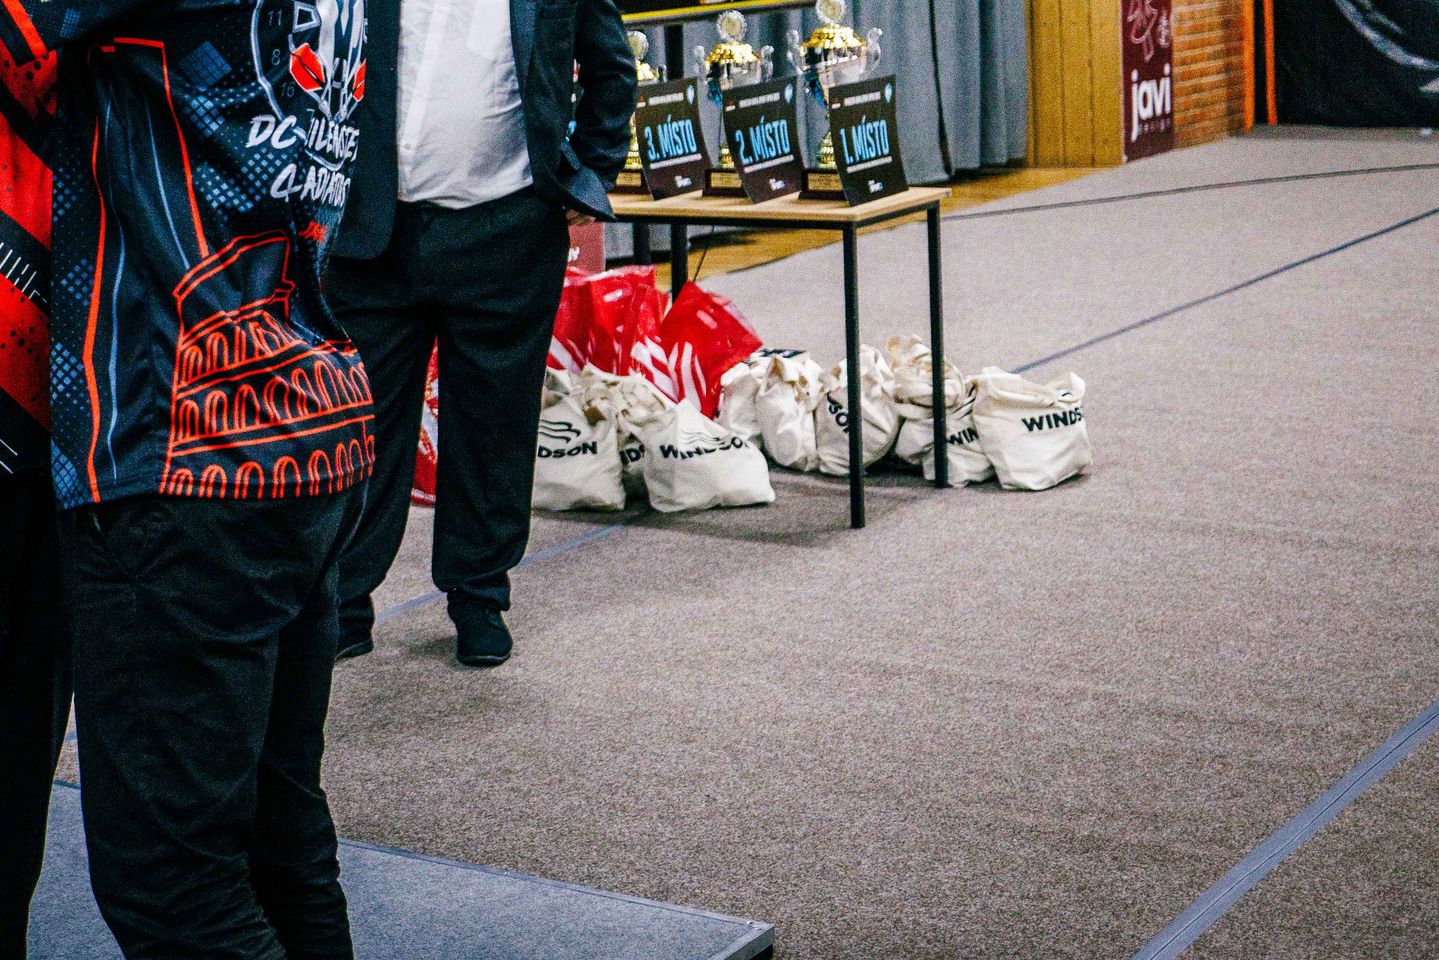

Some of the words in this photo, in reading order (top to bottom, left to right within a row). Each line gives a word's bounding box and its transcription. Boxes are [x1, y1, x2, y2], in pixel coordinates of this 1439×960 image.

[267, 9, 283, 26] 11
[271, 48, 281, 67] 8
[280, 81, 295, 98] 16
[245, 114, 298, 150] DC
[644, 126, 660, 161] 3.
[658, 114, 697, 159] MÍSTO
[735, 129, 753, 165] 2.
[749, 115, 791, 162] MÍSTO
[840, 127, 854, 165] 1.
[851, 114, 890, 162] MÍSTO
[537, 441, 598, 458] DSON
